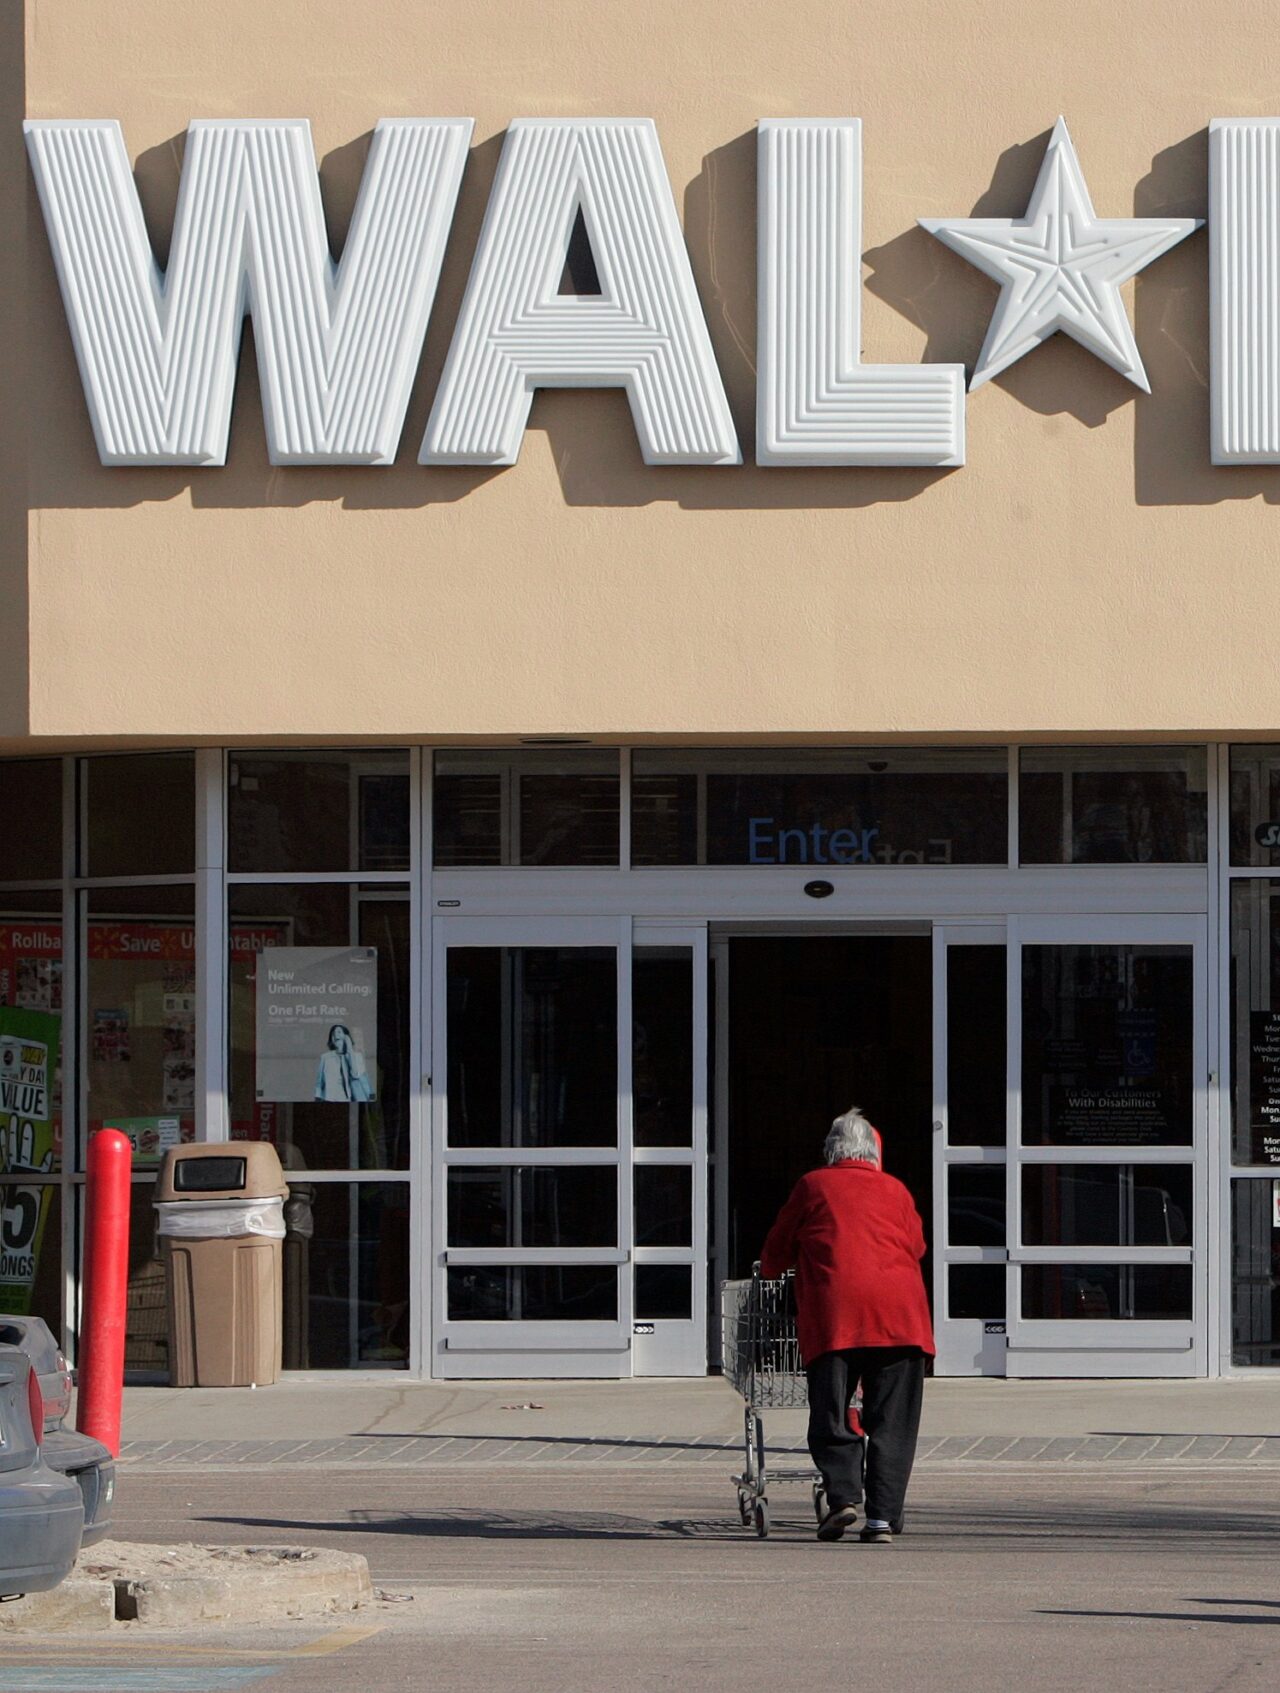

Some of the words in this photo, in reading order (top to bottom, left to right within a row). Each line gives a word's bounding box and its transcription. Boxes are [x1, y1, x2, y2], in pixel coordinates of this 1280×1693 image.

[749, 818, 879, 863] Enter
[12, 931, 63, 949] Rollba
[120, 933, 160, 952] Save
[268, 969, 294, 980] New
[268, 983, 326, 994] Unlimited
[268, 1004, 293, 1016] One
[295, 1004, 318, 1016] Flat
[1081, 1088, 1100, 1097] Our
[1104, 1088, 1162, 1098] Customers
[1068, 1098, 1095, 1108] With
[1098, 1098, 1156, 1108] Disabilities
